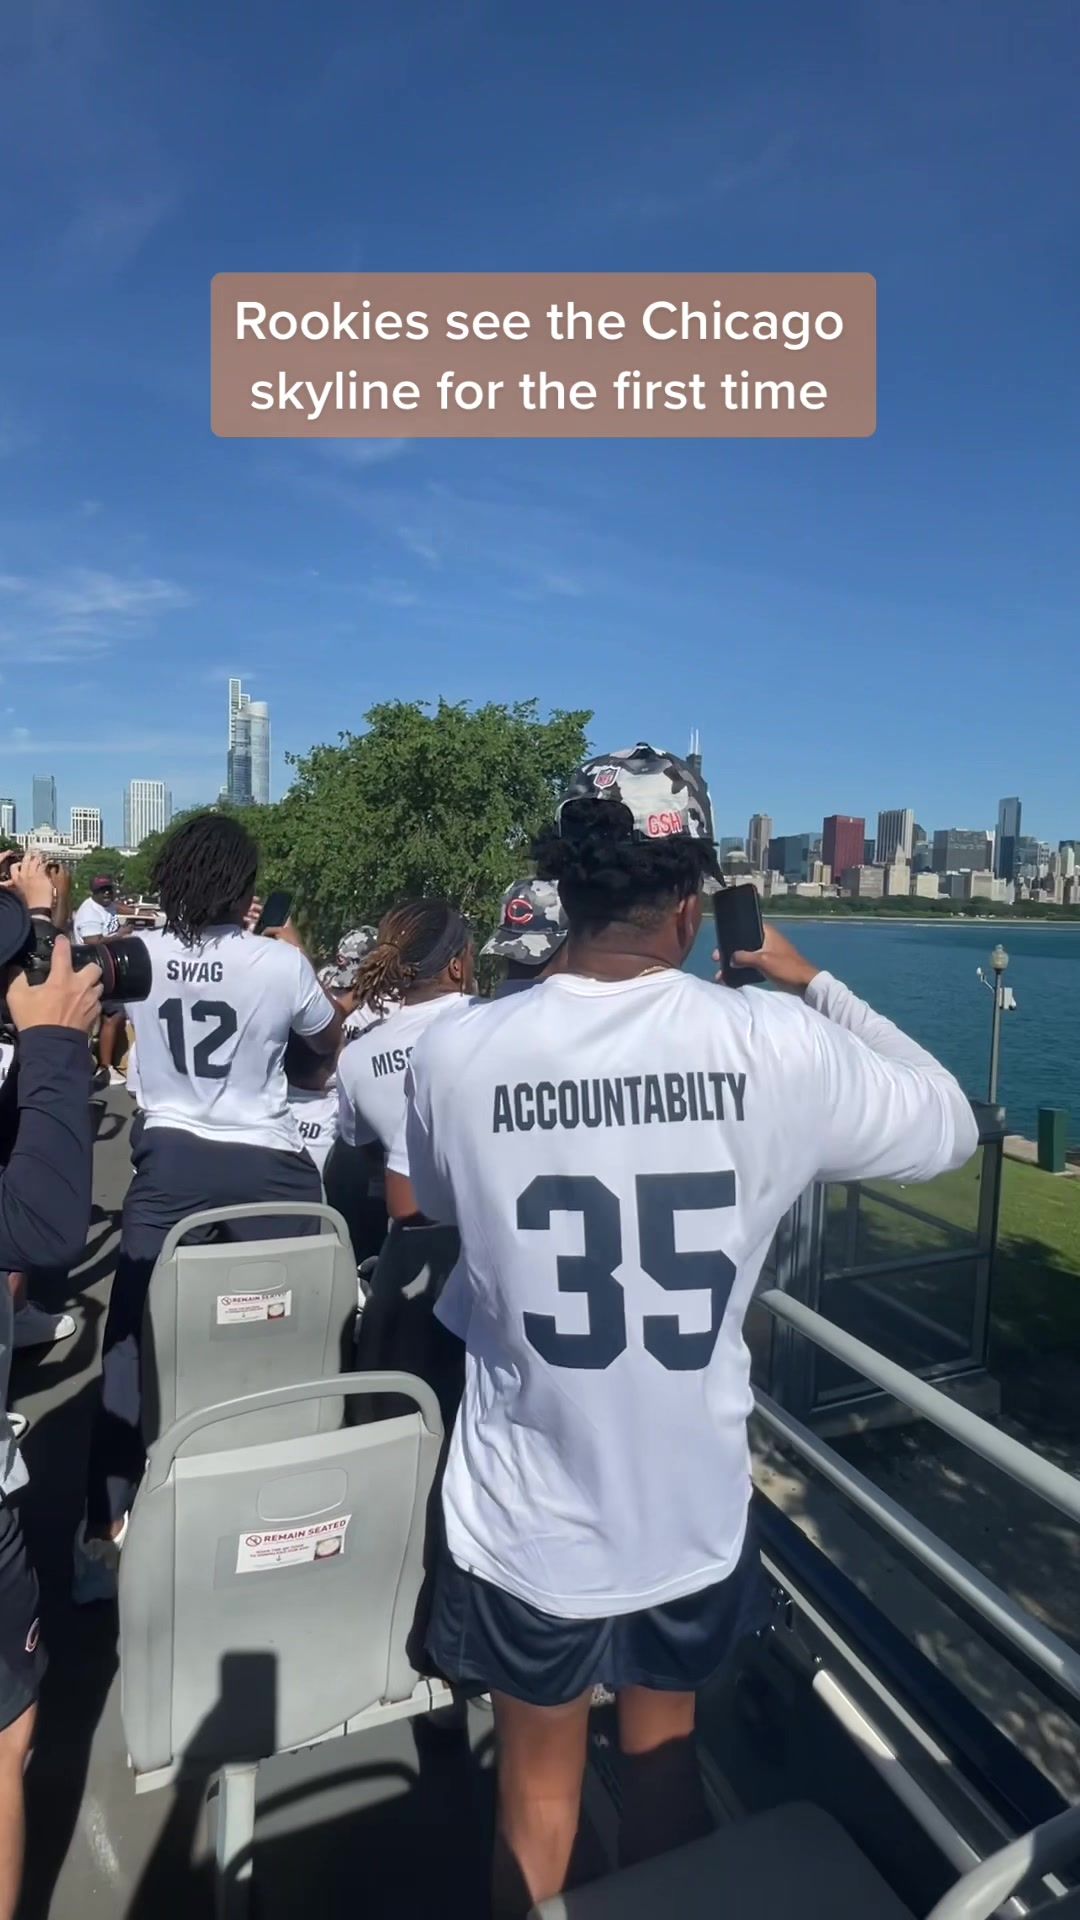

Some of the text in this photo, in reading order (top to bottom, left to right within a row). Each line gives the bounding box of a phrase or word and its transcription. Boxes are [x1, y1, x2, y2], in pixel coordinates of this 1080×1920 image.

[647, 811, 682, 835] GSH
[167, 960, 223, 982] SWAG
[158, 998, 237, 1079] 12
[492, 1071, 747, 1133] ACCOUNTABILTY
[296, 1120, 321, 1139] RD
[516, 1169, 737, 1371] 35
[263, 1520, 346, 1543] REMAIN SEATED
